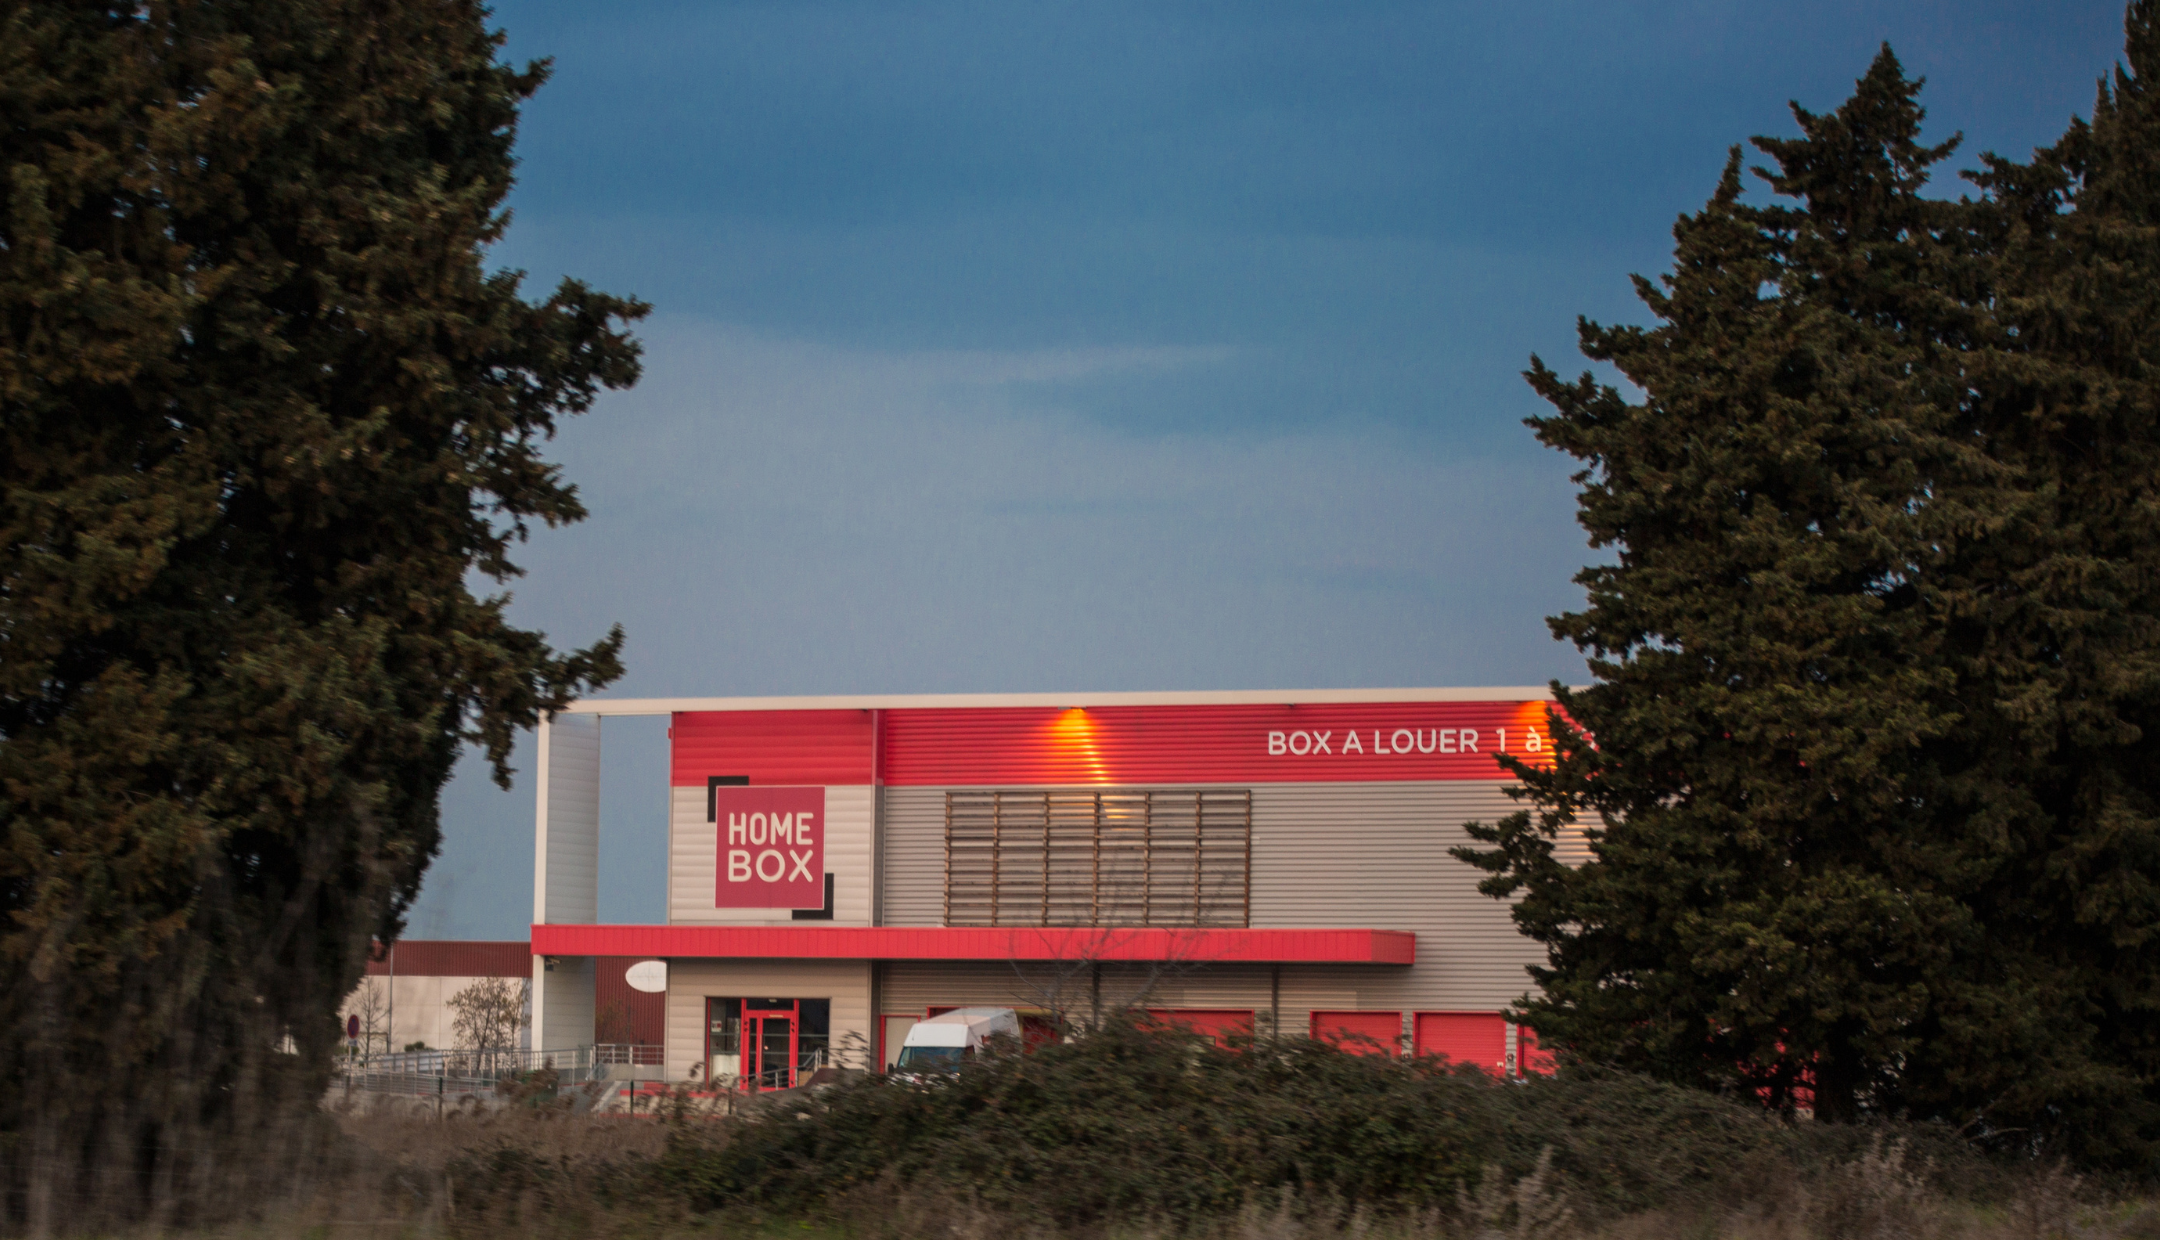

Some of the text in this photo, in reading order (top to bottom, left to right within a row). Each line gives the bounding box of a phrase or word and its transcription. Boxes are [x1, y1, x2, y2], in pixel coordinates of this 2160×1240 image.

[1268, 731, 1332, 755] BOX
[1342, 730, 1364, 755] A
[1374, 728, 1479, 754] LOUER
[1496, 728, 1506, 752] 1
[1525, 726, 1542, 752] à
[729, 812, 814, 845] HOME
[728, 849, 814, 883] BOX
